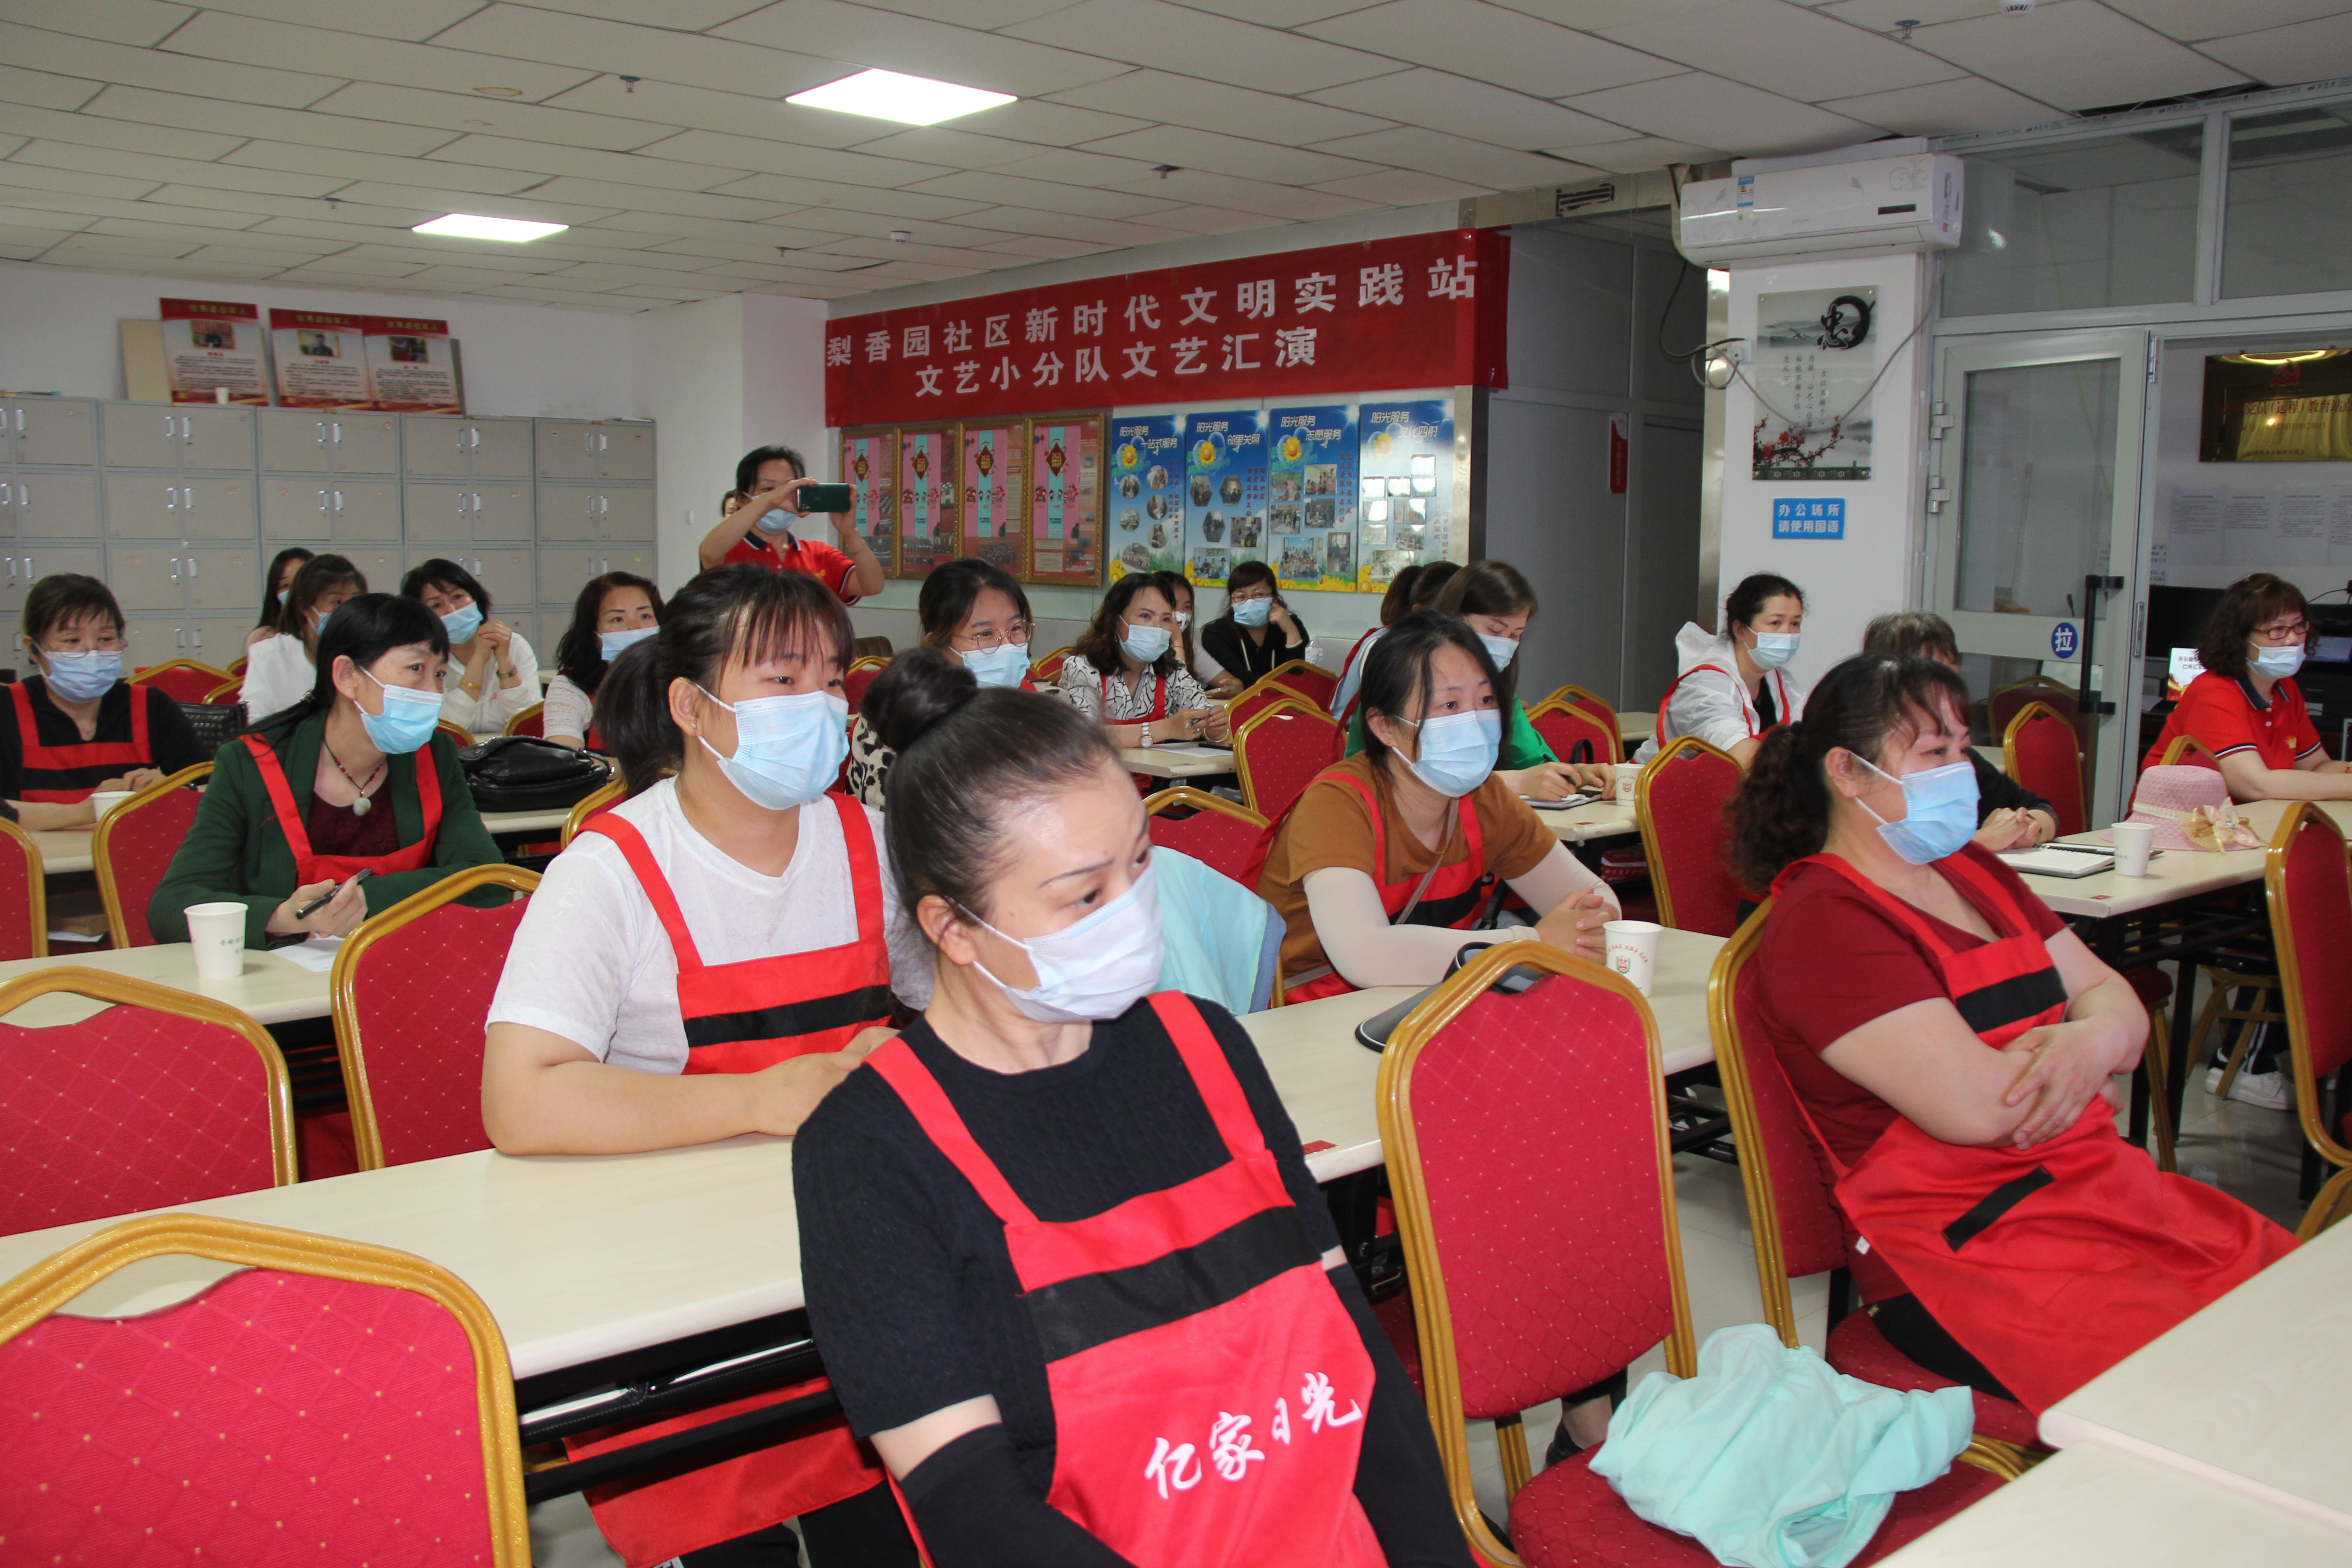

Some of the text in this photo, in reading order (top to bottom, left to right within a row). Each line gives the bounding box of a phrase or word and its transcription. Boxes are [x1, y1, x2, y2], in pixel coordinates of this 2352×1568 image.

[826, 255, 1478, 367] 梨香园社区新时代文明实践站
[1816, 304, 1848, 350] 忠
[916, 326, 1318, 397] 文艺小分队文艺汇演
[1281, 415, 1316, 427] 阳光服务
[1371, 411, 1410, 423] 阳光服务
[1119, 426, 1149, 436] 阳光服务
[1196, 421, 1229, 432] 阳光服务
[1398, 425, 1438, 438] 文化四射
[1227, 434, 1260, 446] 邻里关照
[1305, 429, 1342, 441] 志愿服务
[1141, 437, 1178, 449] 一站式服务
[1779, 502, 1840, 517] 办公场所
[1778, 519, 1839, 534] 请使用国语
[2055, 627, 2073, 652] 拉
